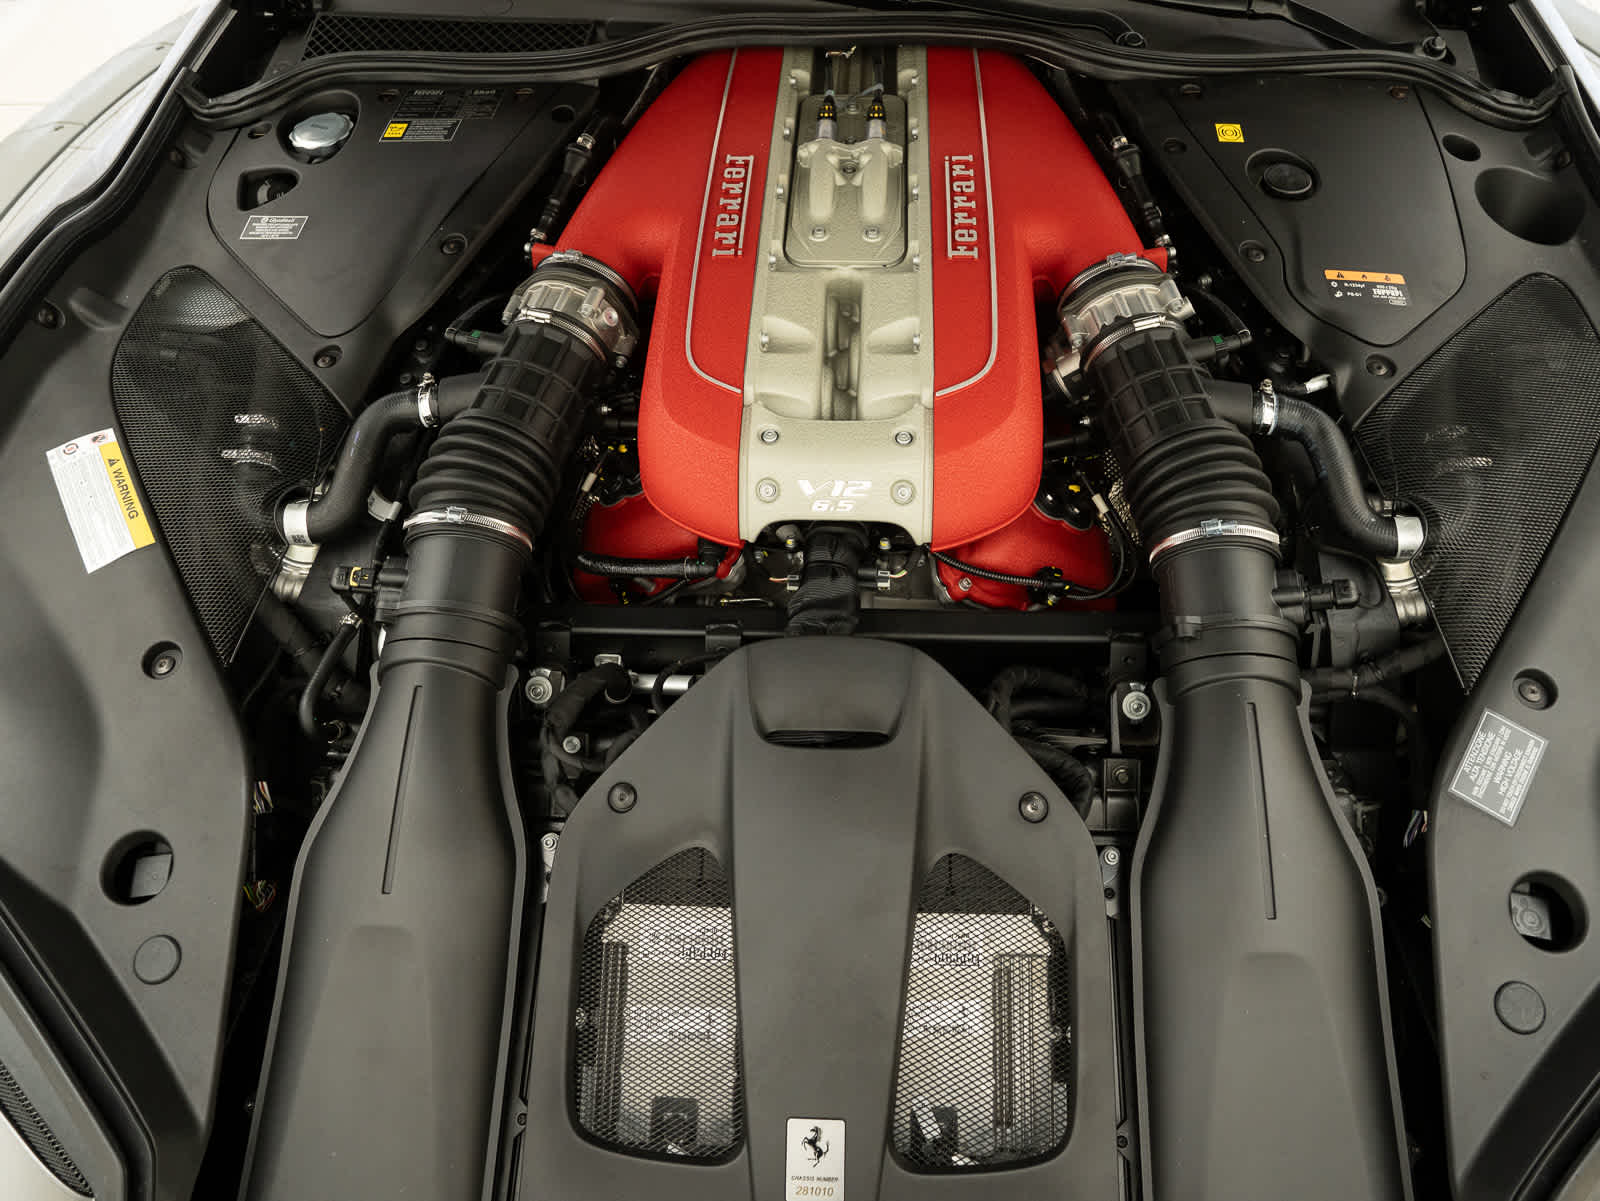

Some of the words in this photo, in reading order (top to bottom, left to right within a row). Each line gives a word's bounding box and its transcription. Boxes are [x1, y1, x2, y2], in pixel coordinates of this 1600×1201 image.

[712, 154, 754, 257] Ferrari
[944, 154, 979, 259] Ferrari
[112, 467, 139, 520] WARNING
[797, 479, 873, 497] V12
[811, 499, 857, 512] 6.5
[795, 1185, 835, 1197] 281010
